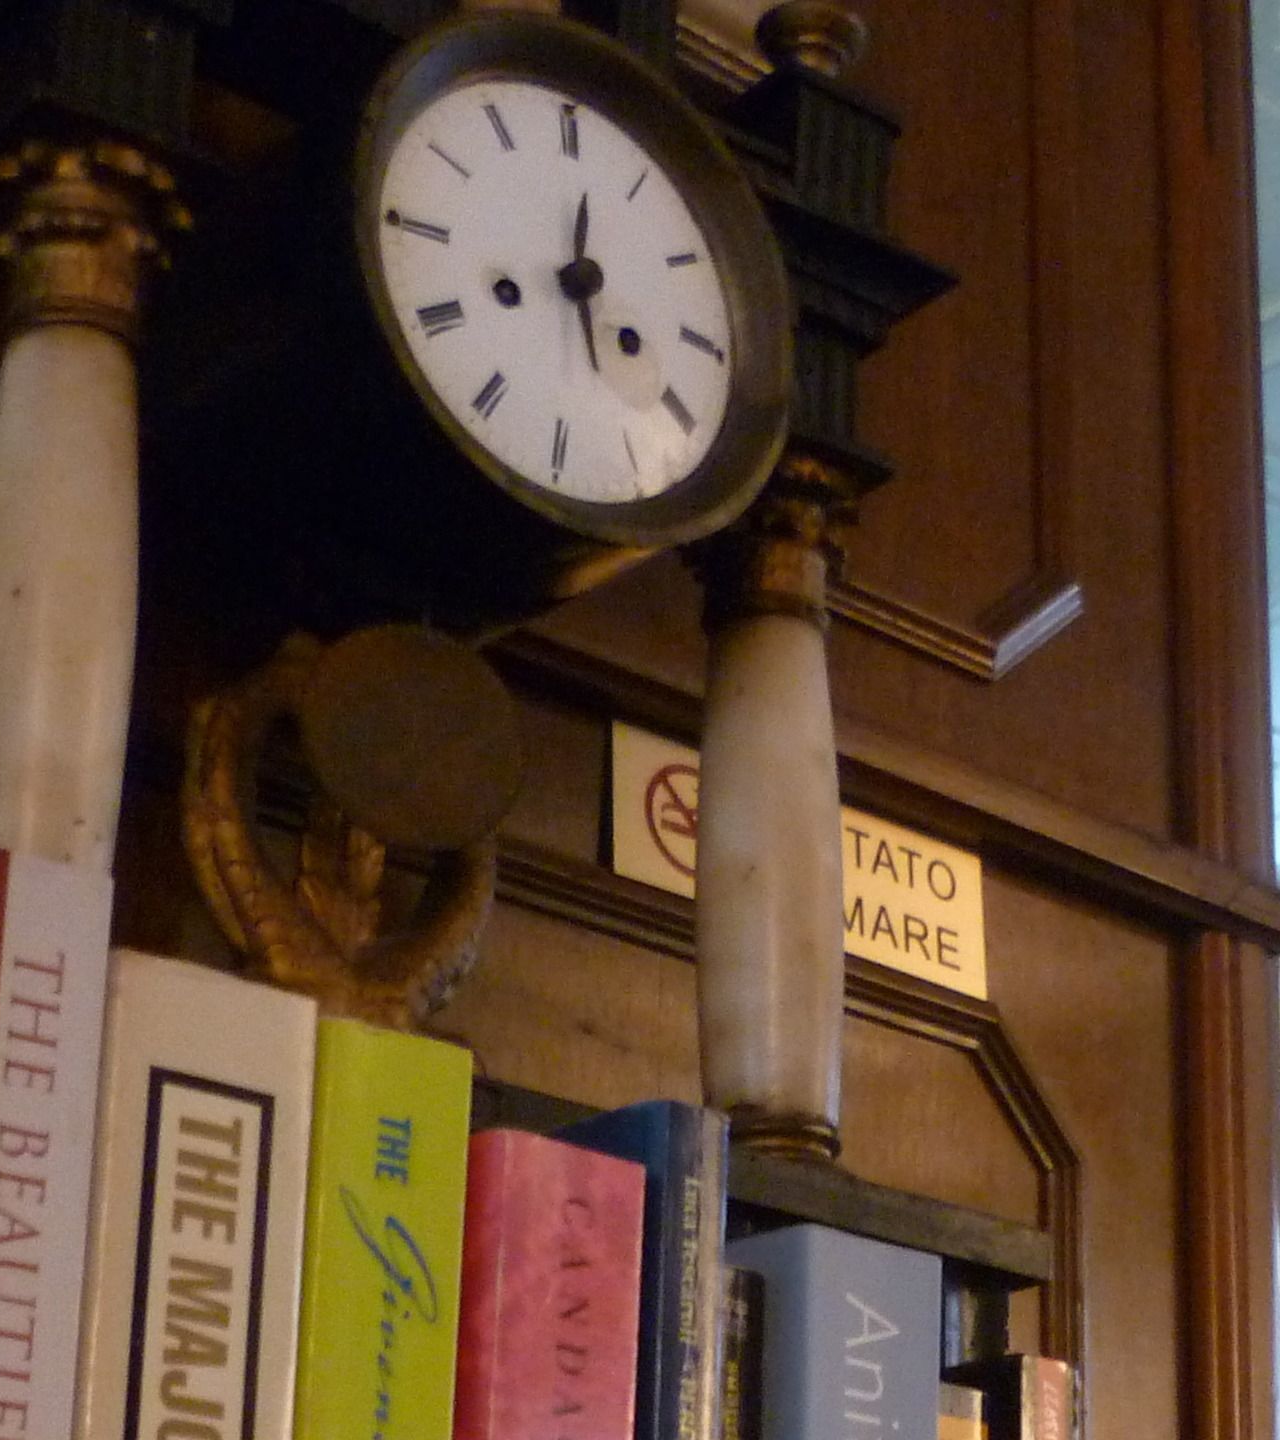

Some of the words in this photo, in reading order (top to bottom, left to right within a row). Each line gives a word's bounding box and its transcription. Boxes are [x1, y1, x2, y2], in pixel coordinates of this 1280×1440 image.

[846, 826, 957, 901] TATO
[843, 897, 962, 972] MARE
[4, 952, 65, 1094] THE
[172, 1116, 243, 1246] THE
[374, 1115, 412, 1186] THE
